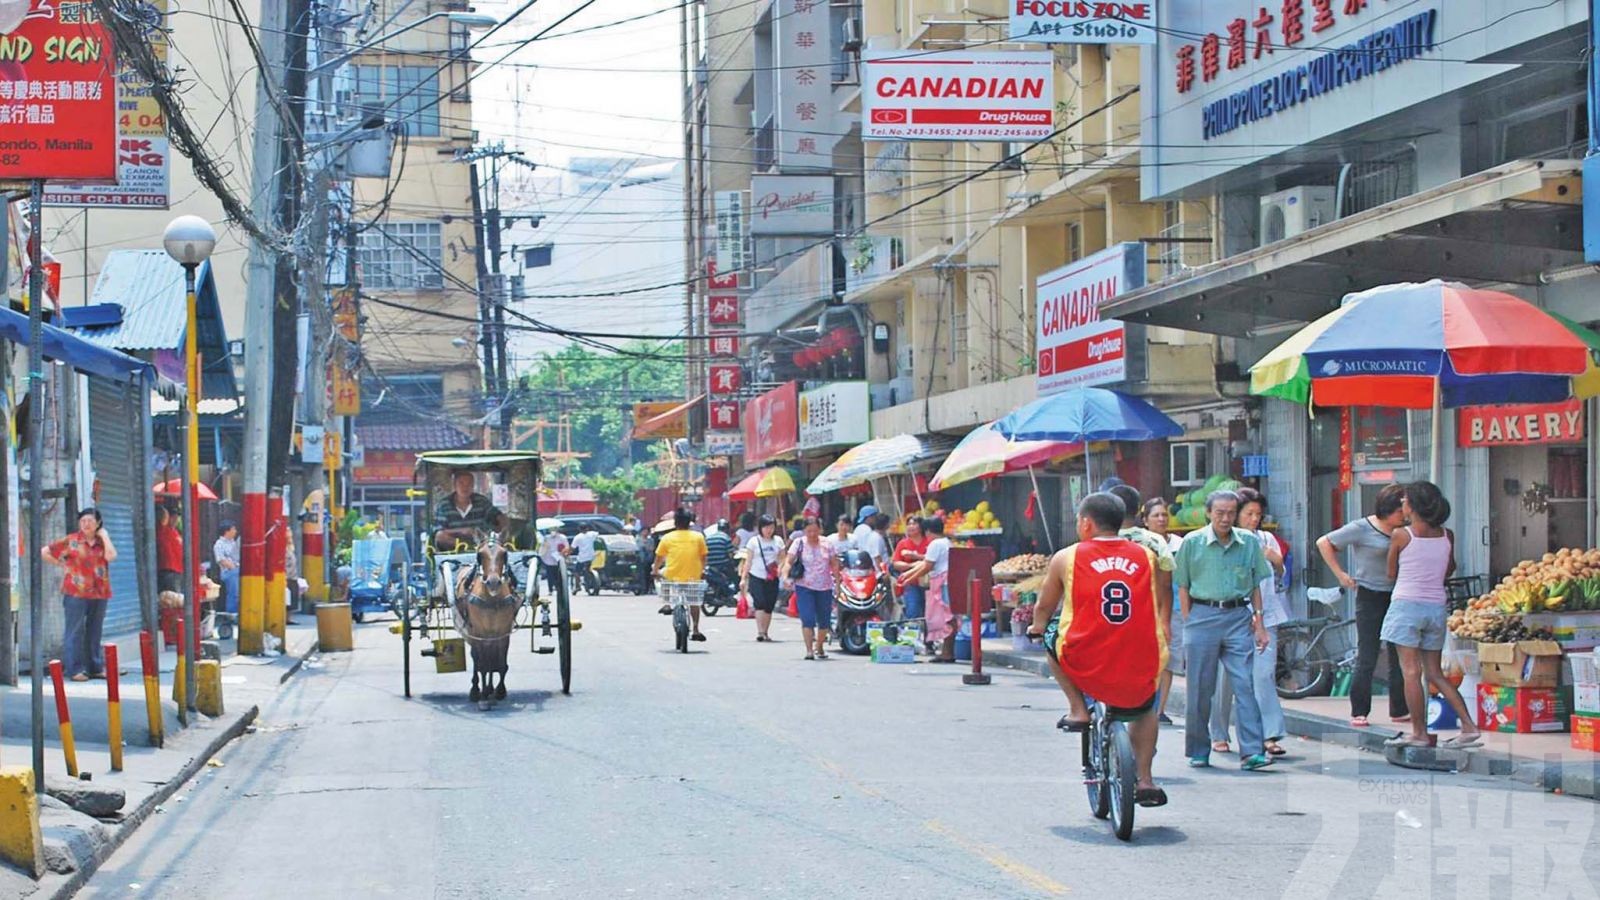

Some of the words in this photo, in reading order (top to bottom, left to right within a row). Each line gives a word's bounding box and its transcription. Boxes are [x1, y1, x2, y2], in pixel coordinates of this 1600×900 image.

[1016, 0, 1089, 18] FOCUS
[1093, 1, 1150, 19] ZONE
[1029, 21, 1063, 35] Art
[1073, 22, 1137, 38] Studio
[44, 36, 101, 63] SIGN
[1202, 79, 1273, 141] PHILIPPINE
[1334, 9, 1436, 88] FRATERNITY
[876, 77, 1044, 99] CANADIAN
[979, 111, 1008, 123] Drug
[1009, 112, 1047, 122] House
[45, 139, 94, 150] Manila
[86, 196, 122, 204] CD-R
[127, 196, 165, 205] KING
[1345, 361, 1427, 372] MICROMATIC
[1471, 410, 1579, 442] BAKERY
[1101, 580, 1131, 624] 8
